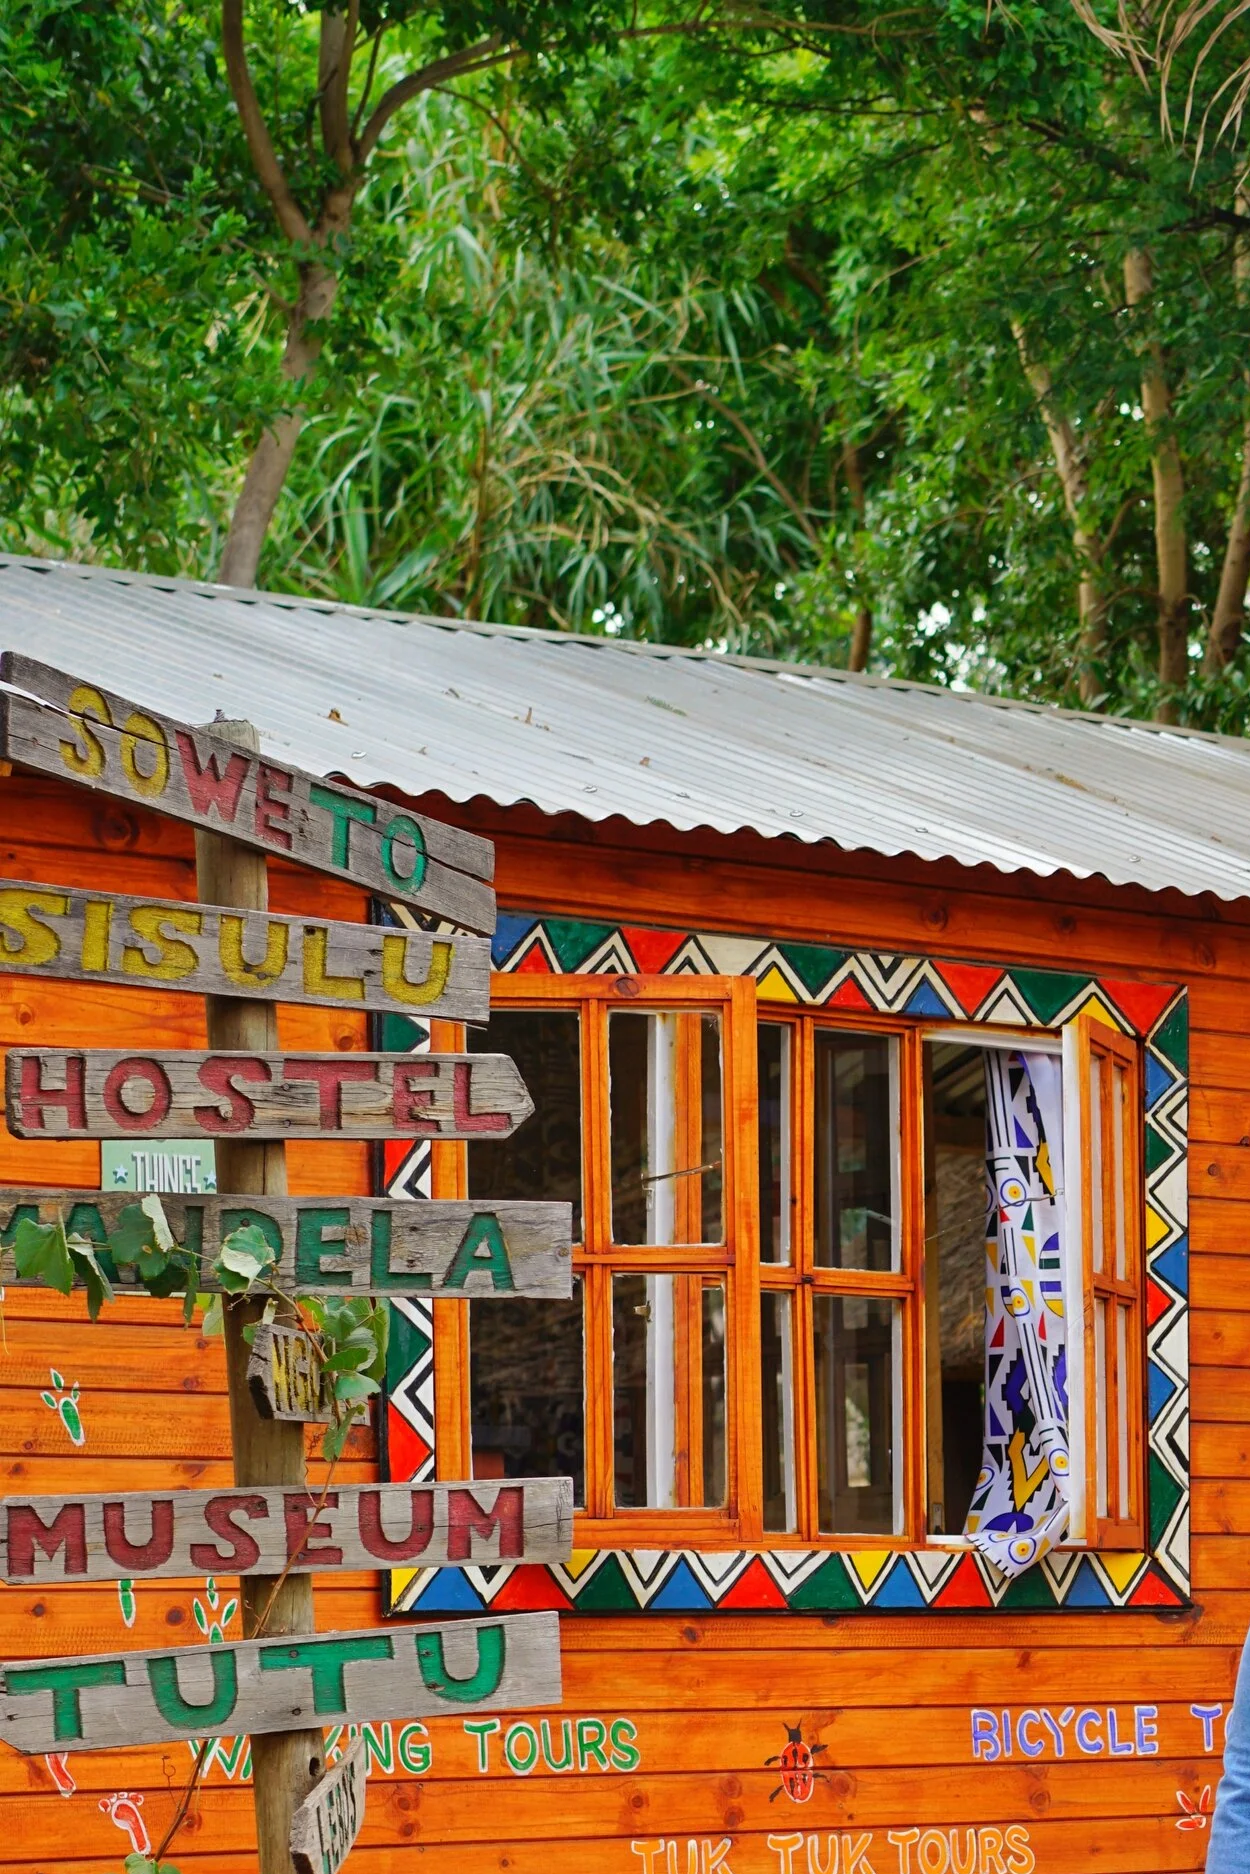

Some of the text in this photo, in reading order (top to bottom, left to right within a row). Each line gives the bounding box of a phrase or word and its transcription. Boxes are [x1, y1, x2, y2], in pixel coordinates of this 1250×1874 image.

[59, 685, 427, 896] SOWETO
[0, 889, 455, 1006] SISULU
[20, 1056, 512, 1132] HOSTEL
[132, 1151, 201, 1193] THINGS
[8, 1485, 524, 1576] MUSEUM
[4, 1624, 507, 1741] TUTU
[464, 1718, 640, 1775] TOURS
[971, 1704, 1158, 1762] BICYCLE
